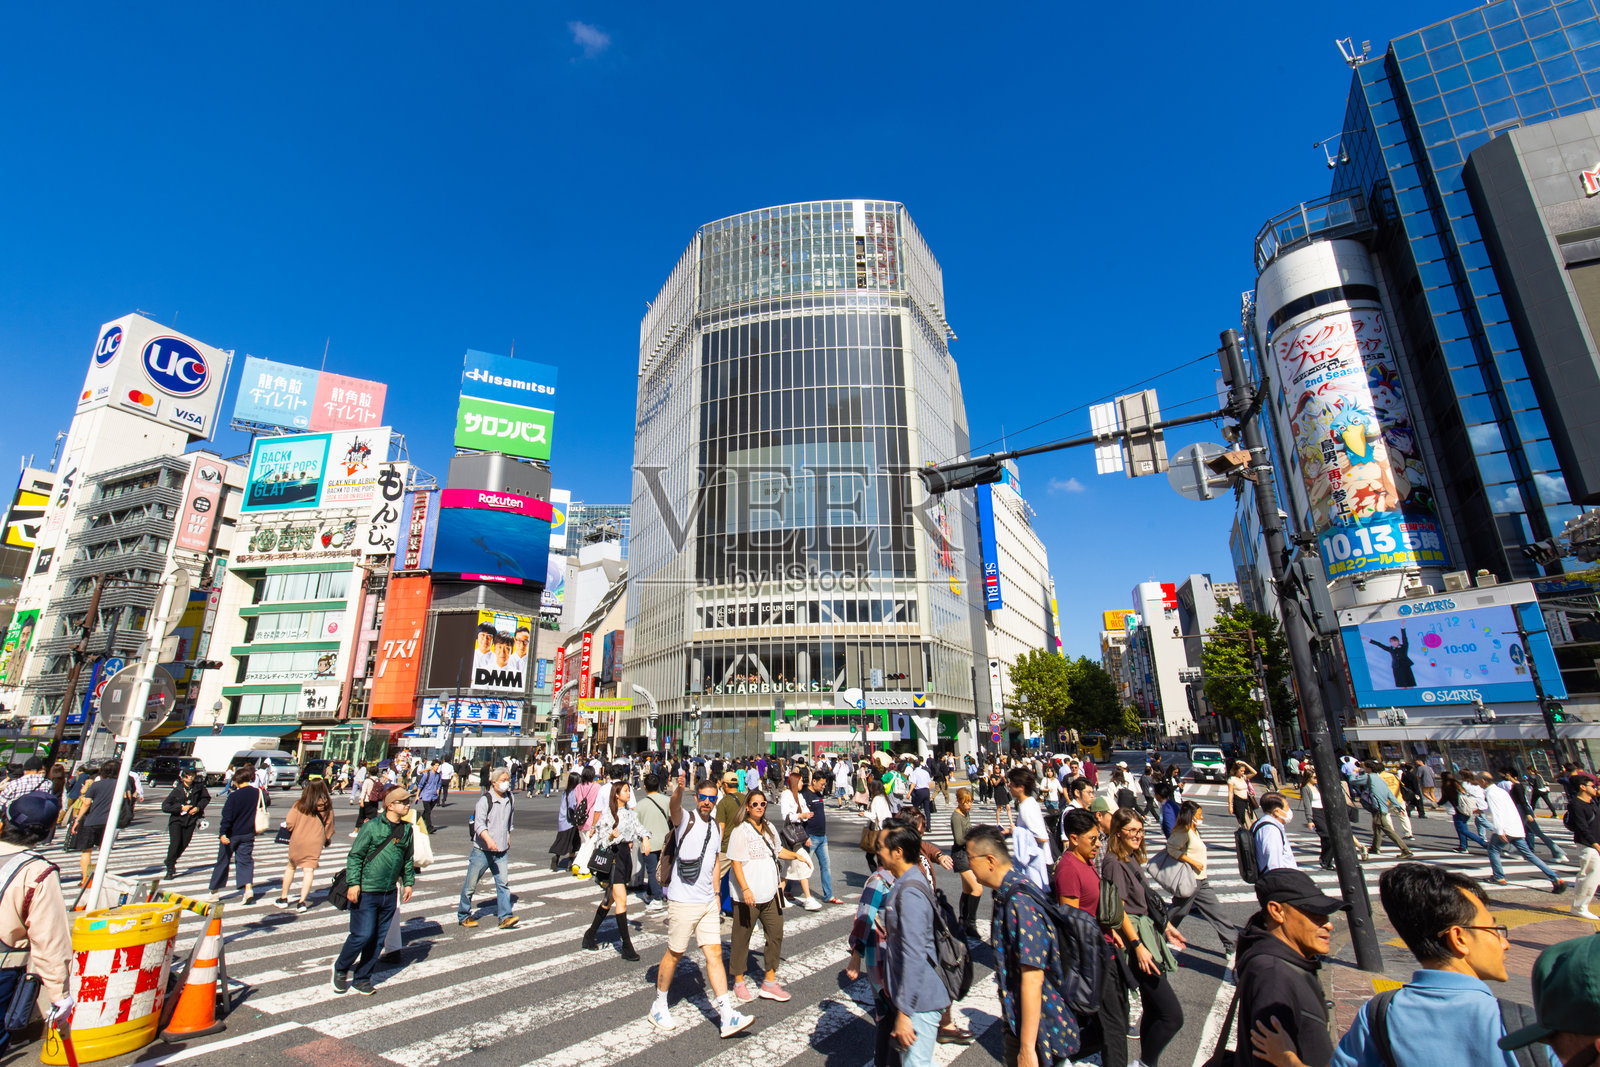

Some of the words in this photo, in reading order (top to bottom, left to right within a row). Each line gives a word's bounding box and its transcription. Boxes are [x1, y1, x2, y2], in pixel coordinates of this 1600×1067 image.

[97, 332, 120, 357] UC
[149, 343, 202, 385] UC
[258, 372, 303, 394] 龍角散
[466, 368, 556, 396] Hisamitsu
[1304, 374, 1324, 389] 2nd
[1325, 365, 1366, 381] Season
[331, 387, 373, 408] 龍角散
[175, 407, 203, 425] VISA
[464, 411, 546, 444] サロンパス
[261, 450, 289, 463] BACK
[273, 462, 292, 473] THE
[293, 459, 318, 472] POPS
[254, 481, 288, 498] GLAY
[368, 463, 404, 551] もんじゃ
[478, 492, 524, 509] Rakuten
[1322, 524, 1397, 564] 10.13
[39, 554, 51, 566] 7F
[985, 562, 999, 602] SEIBU
[1413, 598, 1457, 614] STARTS
[377, 628, 421, 678] クスリ
[581, 636, 591, 671] カラオケ
[1443, 642, 1477, 655] 10:00
[474, 668, 523, 688] DMM
[715, 681, 821, 695] STARBUCKS
[869, 696, 909, 706] TSUTAYA
[1437, 688, 1482, 703] STARTS
[428, 703, 518, 720] 大盛堂書店
